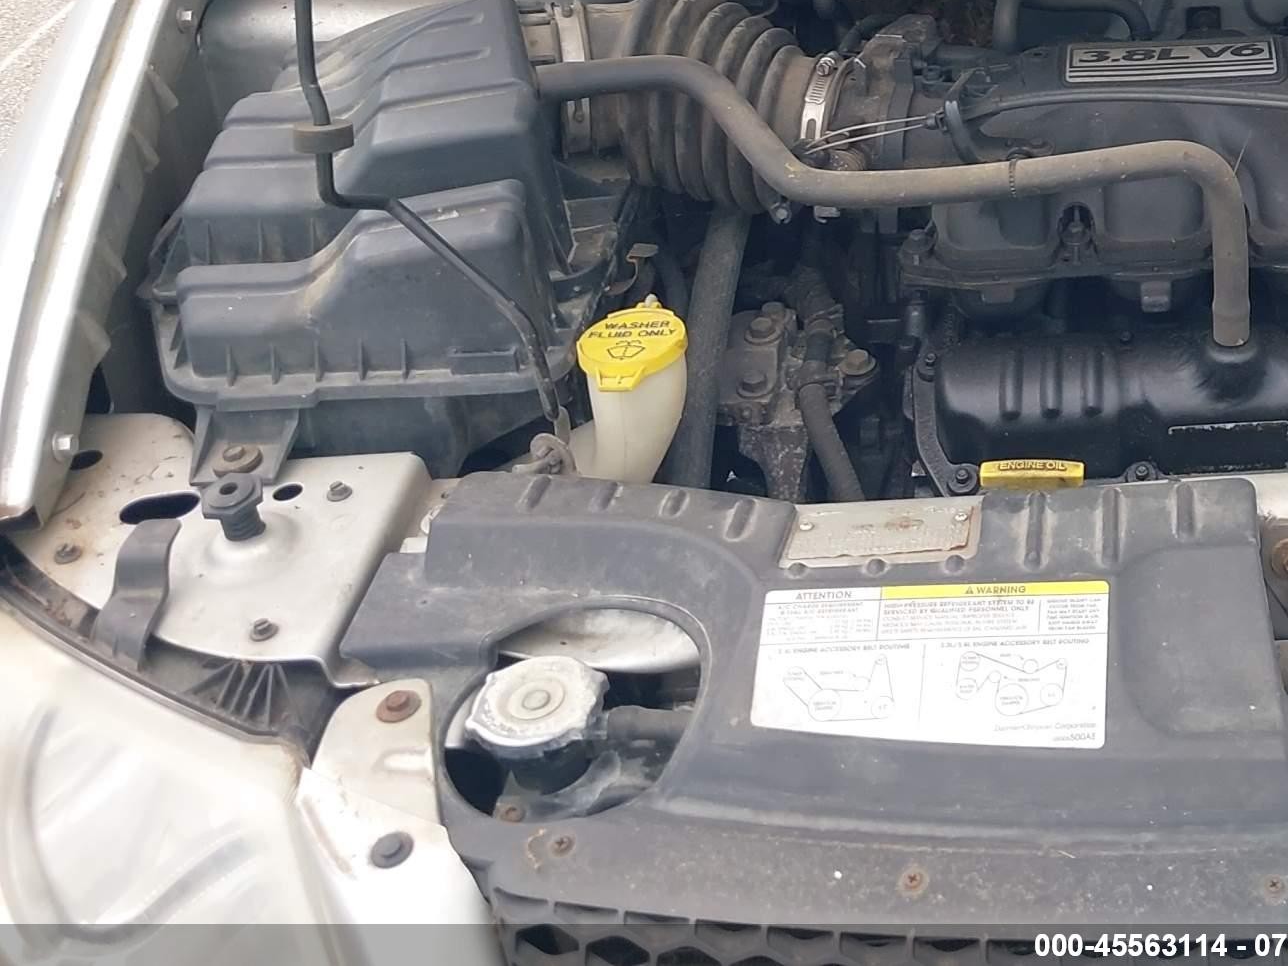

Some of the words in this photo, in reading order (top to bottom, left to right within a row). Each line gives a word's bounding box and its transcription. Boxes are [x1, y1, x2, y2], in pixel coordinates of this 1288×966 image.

[1078, 48, 1189, 63] 3.8L
[1196, 43, 1265, 58] V6
[604, 320, 670, 330] WASHER
[588, 330, 632, 339] FLUID
[638, 328, 677, 337] ONLY
[999, 461, 1045, 471] ENGINE
[1046, 461, 1067, 471] OIL
[976, 585, 1026, 595] WARNING
[795, 590, 852, 601] ATTENTION
